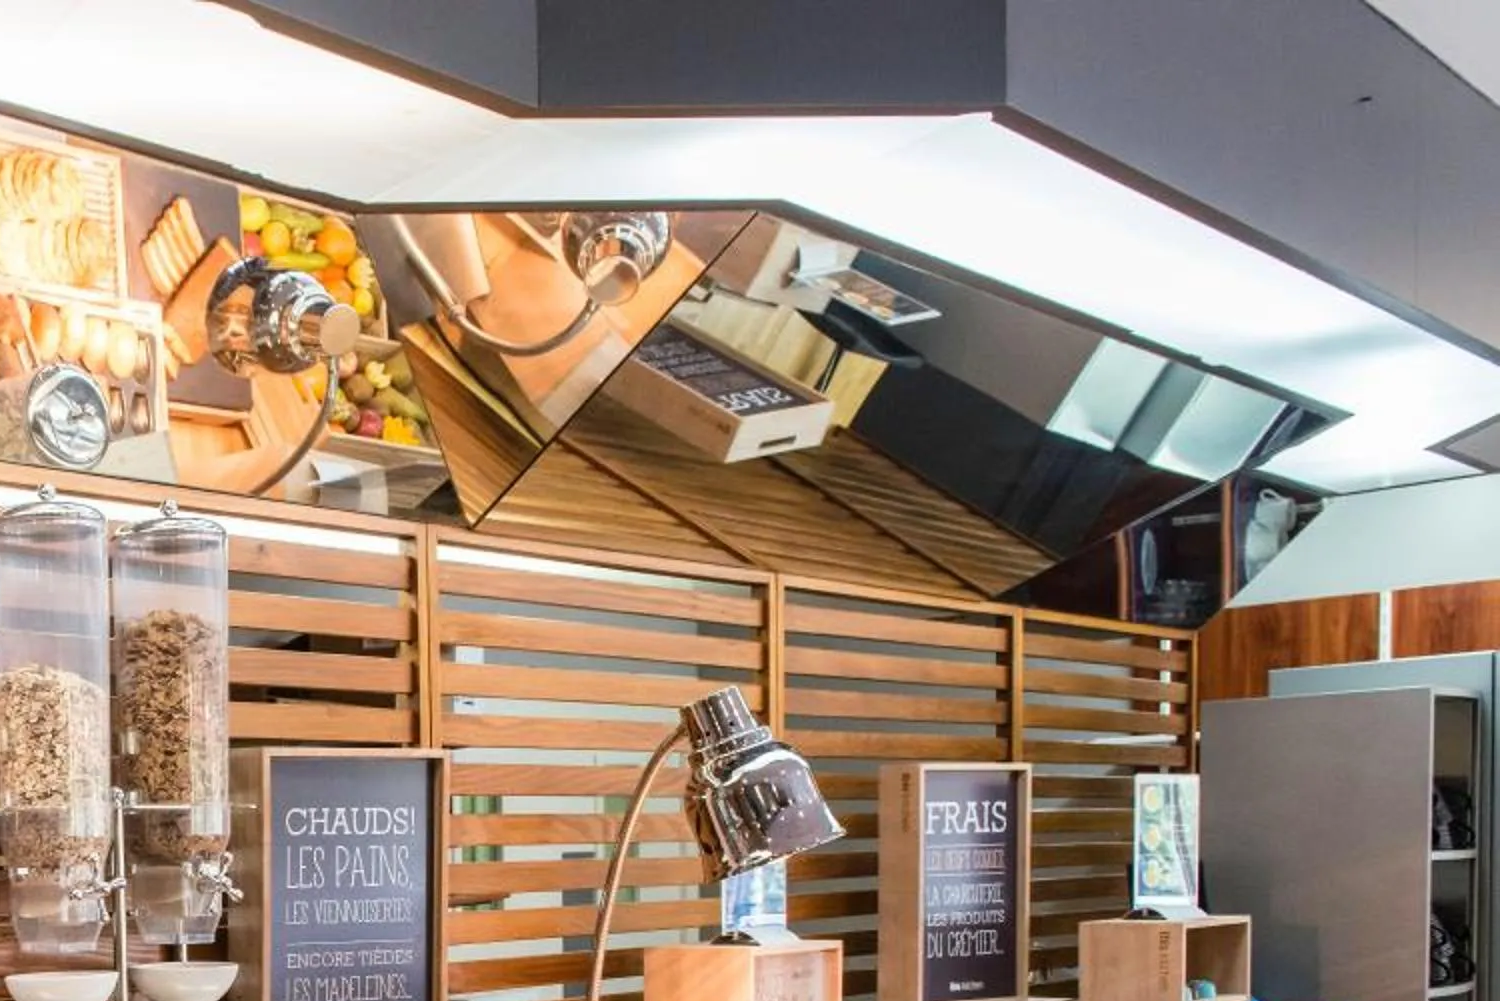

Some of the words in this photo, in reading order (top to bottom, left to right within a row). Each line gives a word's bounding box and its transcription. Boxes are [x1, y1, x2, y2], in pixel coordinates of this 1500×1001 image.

[285, 807, 416, 836] CHAUDS!
[925, 800, 1008, 834] FRAIS
[285, 846, 325, 889] LES
[335, 845, 413, 889] PAINS,
[285, 900, 309, 925] LES
[927, 911, 948, 927] LES
[927, 931, 943, 959] DU
[287, 951, 355, 969] ENCORE
